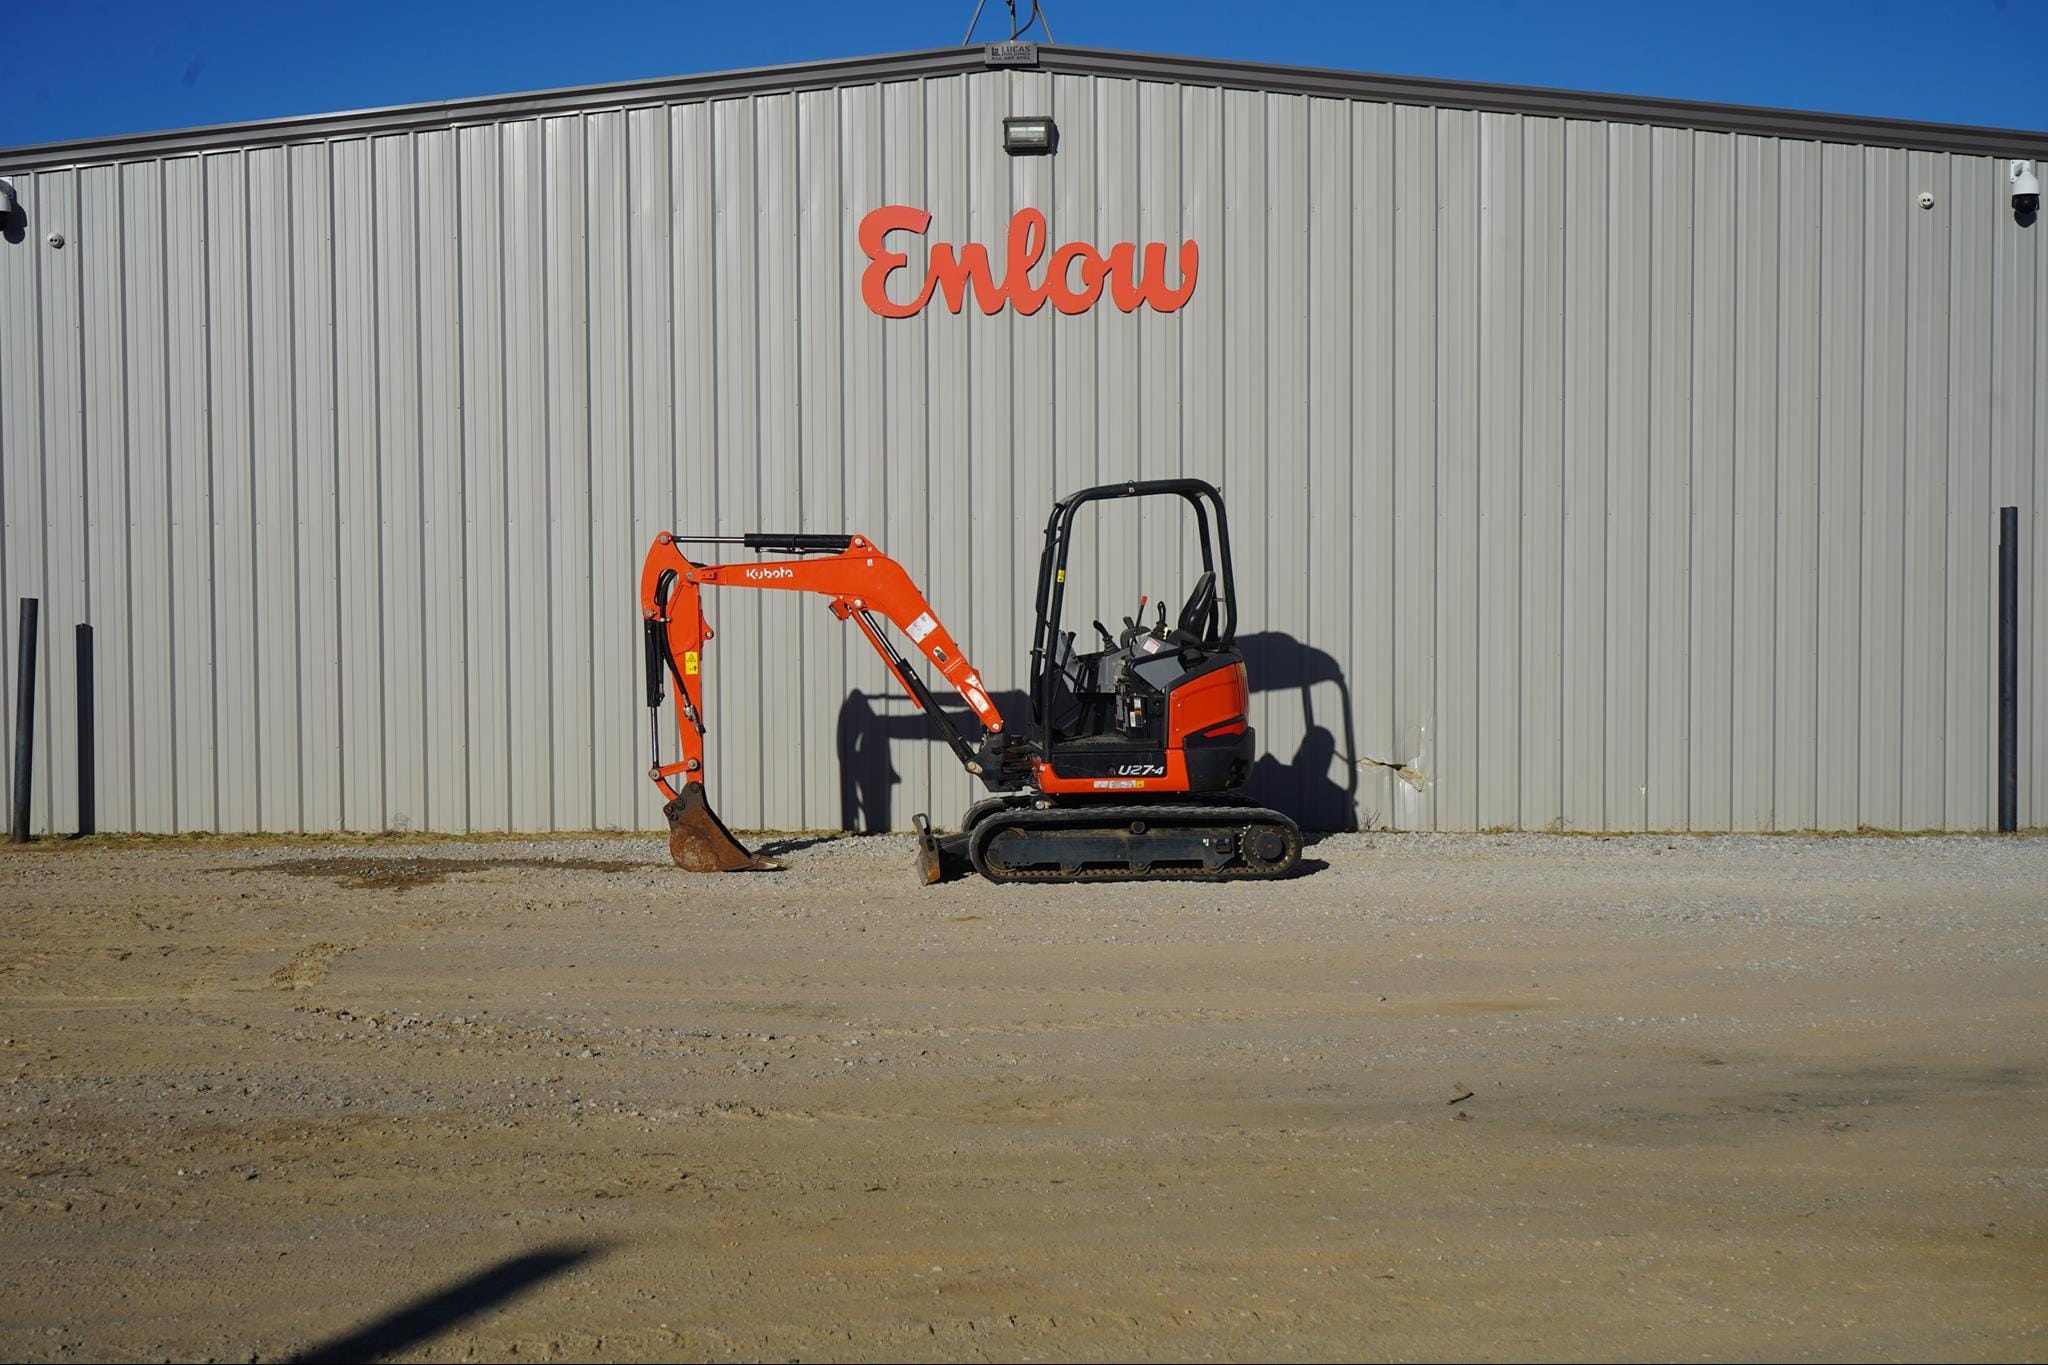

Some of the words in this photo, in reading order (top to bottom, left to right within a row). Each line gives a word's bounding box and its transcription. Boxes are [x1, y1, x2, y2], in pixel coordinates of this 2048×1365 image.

[858, 205, 1198, 318] Enlow
[745, 567, 794, 579] Kubota
[1118, 764, 1165, 776] U27-4
